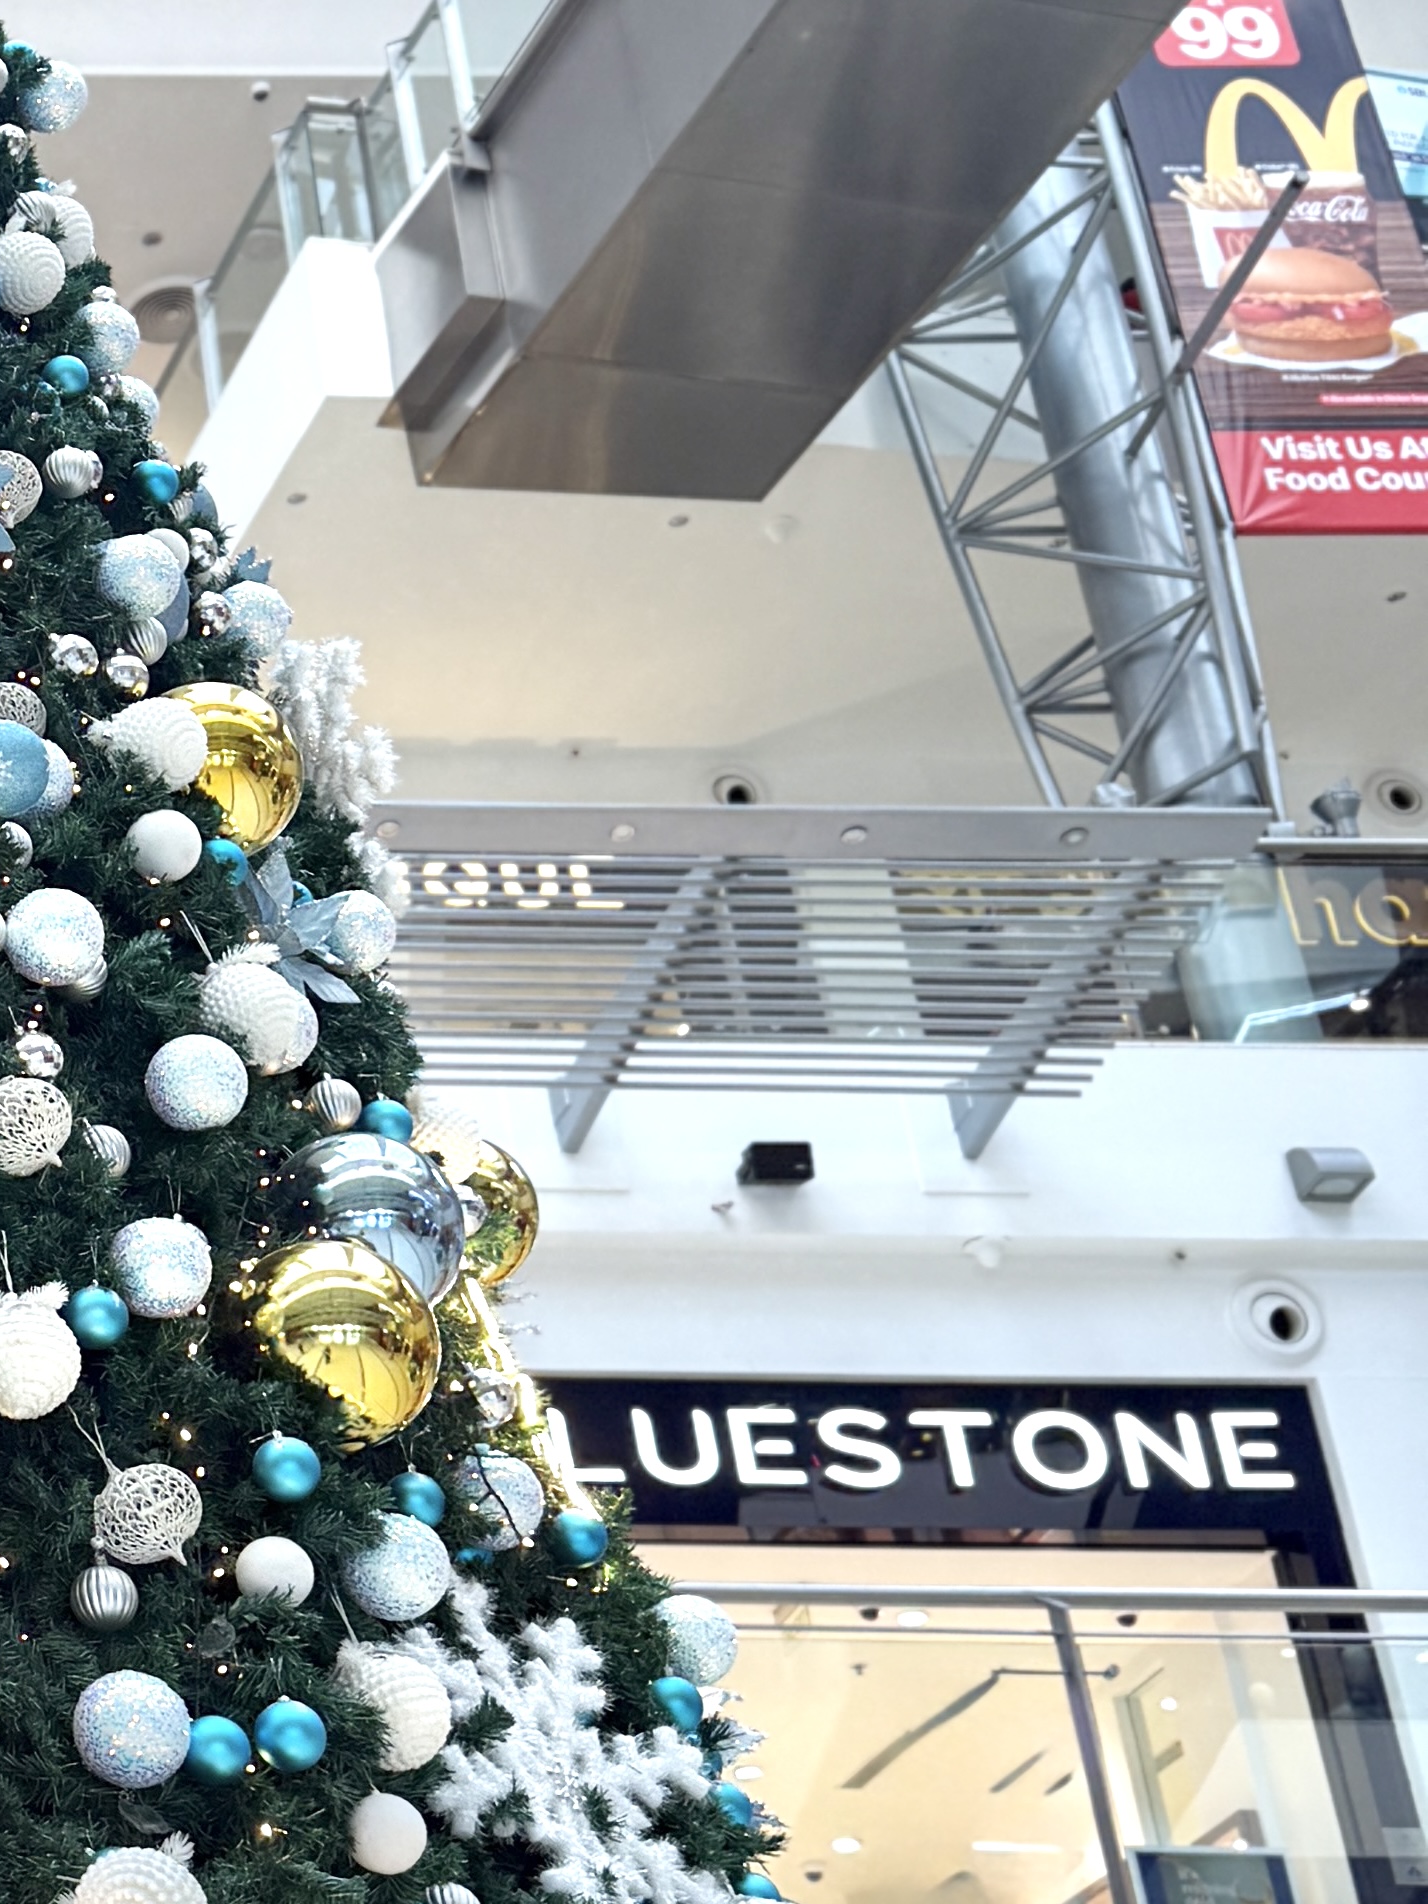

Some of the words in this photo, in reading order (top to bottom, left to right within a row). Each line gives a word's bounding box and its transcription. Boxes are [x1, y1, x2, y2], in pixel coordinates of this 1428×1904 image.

[1260, 434, 1344, 461] Visit
[1345, 435, 1394, 461] Us
[1263, 465, 1352, 492] Food
[545, 1406, 1297, 1492] LUESTONE
